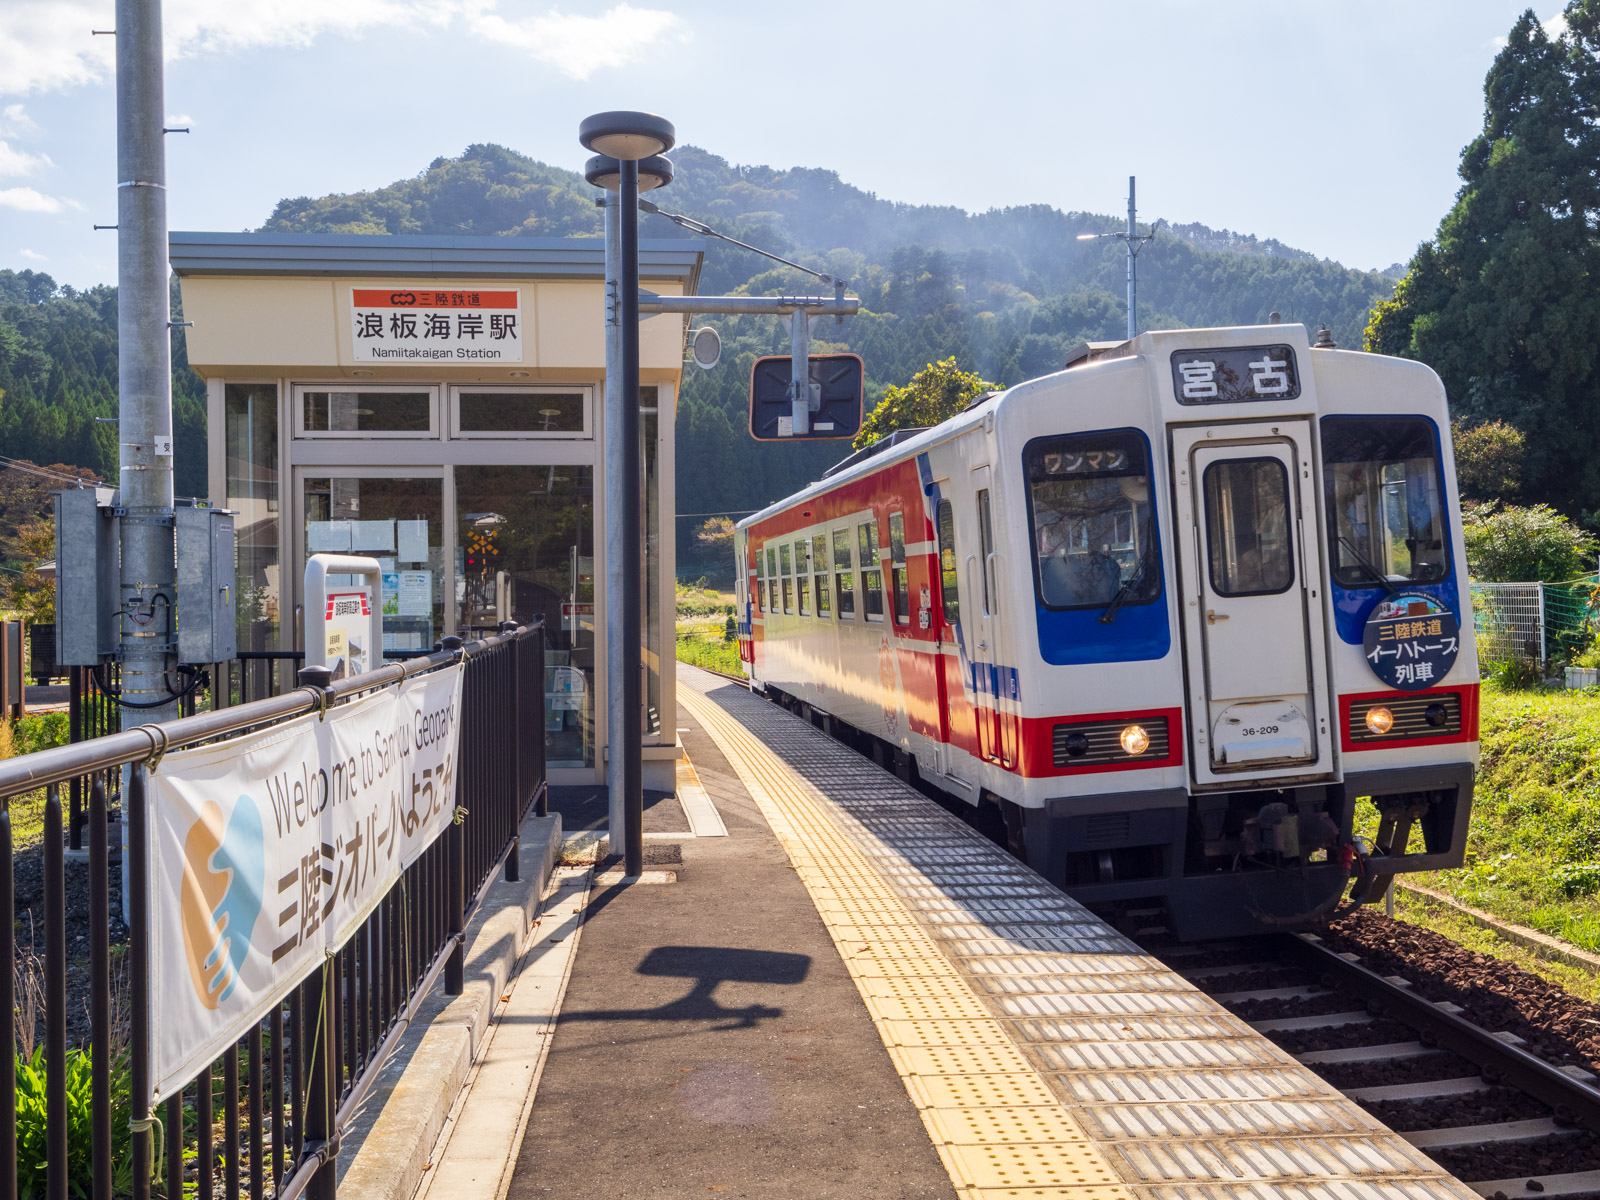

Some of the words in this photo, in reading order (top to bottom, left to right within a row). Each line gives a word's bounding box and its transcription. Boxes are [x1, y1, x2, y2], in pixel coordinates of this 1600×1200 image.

[418, 292, 481, 306] 三陸鉄道
[356, 312, 518, 341] 浪板海岸駅
[371, 346, 453, 360] Namiitakaigan
[456, 347, 501, 359] Station
[1178, 355, 1289, 398] 宮古
[1044, 451, 1124, 472] ワンマン
[1378, 619, 1443, 641] 三陸鉄道
[1366, 636, 1459, 664] イーハトーブ
[1394, 661, 1434, 685] 列車
[1242, 725, 1279, 737] 36-209
[265, 756, 358, 839] Welcome
[360, 740, 374, 790] to
